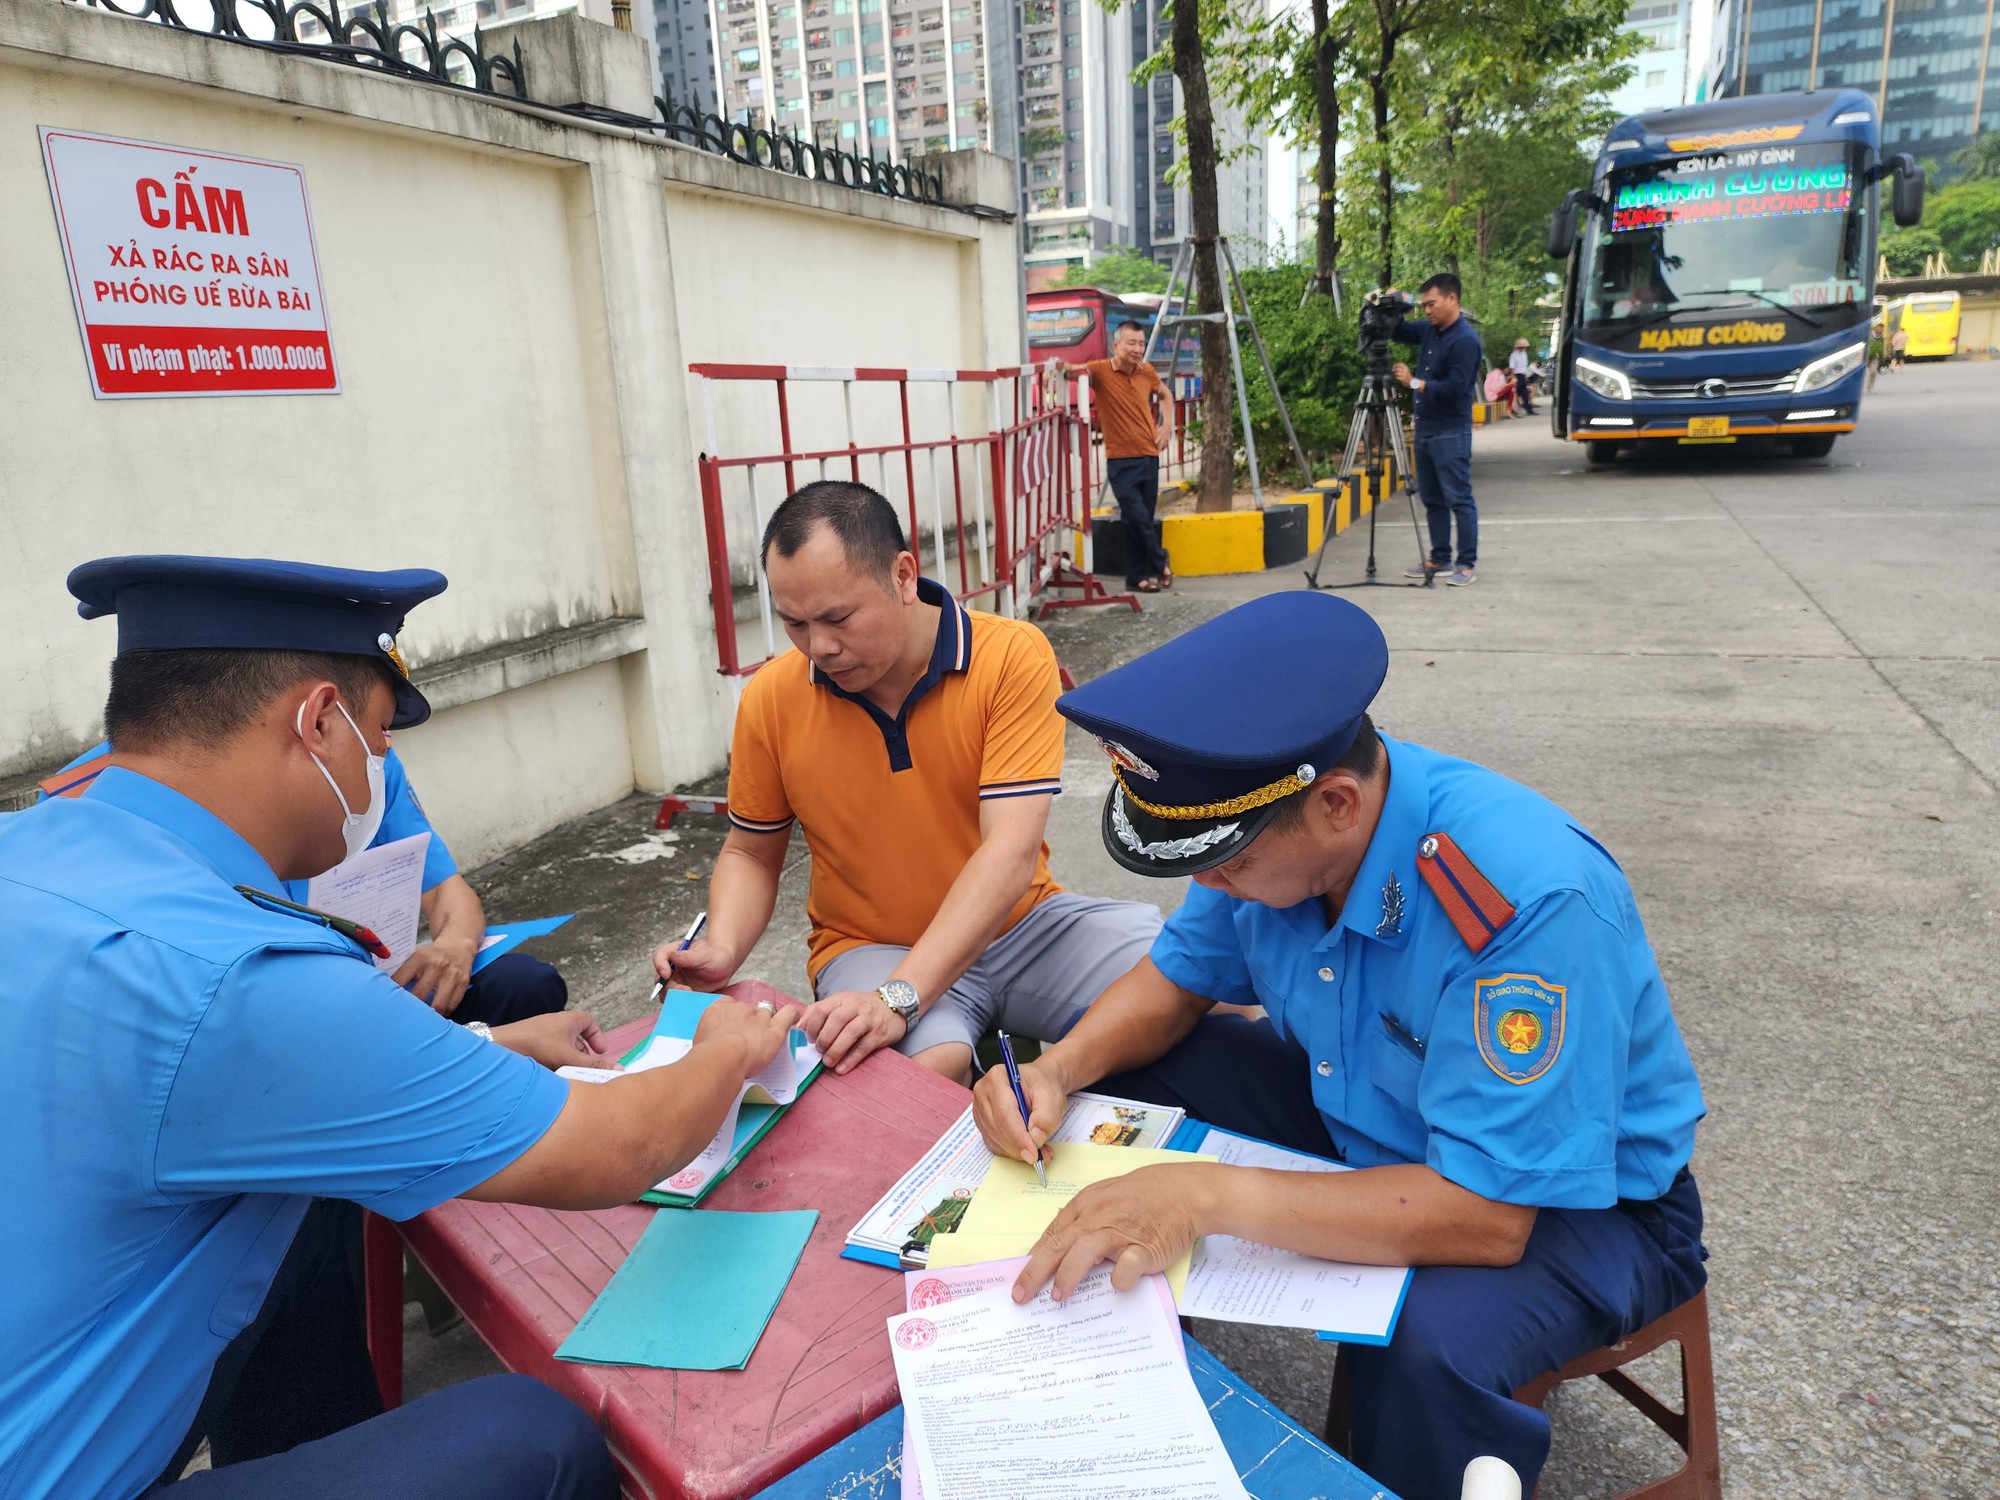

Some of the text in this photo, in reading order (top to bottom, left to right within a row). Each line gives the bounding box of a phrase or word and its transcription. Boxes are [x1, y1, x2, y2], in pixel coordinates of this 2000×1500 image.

[1677, 156, 1705, 174] SƠN
[1705, 154, 1726, 170] LA
[1760, 147, 1795, 164] ĐÌNH
[135, 166, 250, 236] CẤM
[107, 239, 289, 278] XẢ RÁC RA SÂN
[93, 276, 311, 311] PHÓNG UẾ BỪA BÃI
[1638, 319, 1786, 352] MẠNH CƯỜNG
[102, 343, 327, 376] Vi phạm phạt: 1.000.000đ
[1486, 988, 1496, 1000] SỞ
[1495, 986, 1512, 997] GIAO
[1511, 985, 1534, 996] THÔNG
[1534, 989, 1547, 1001] VẬN
